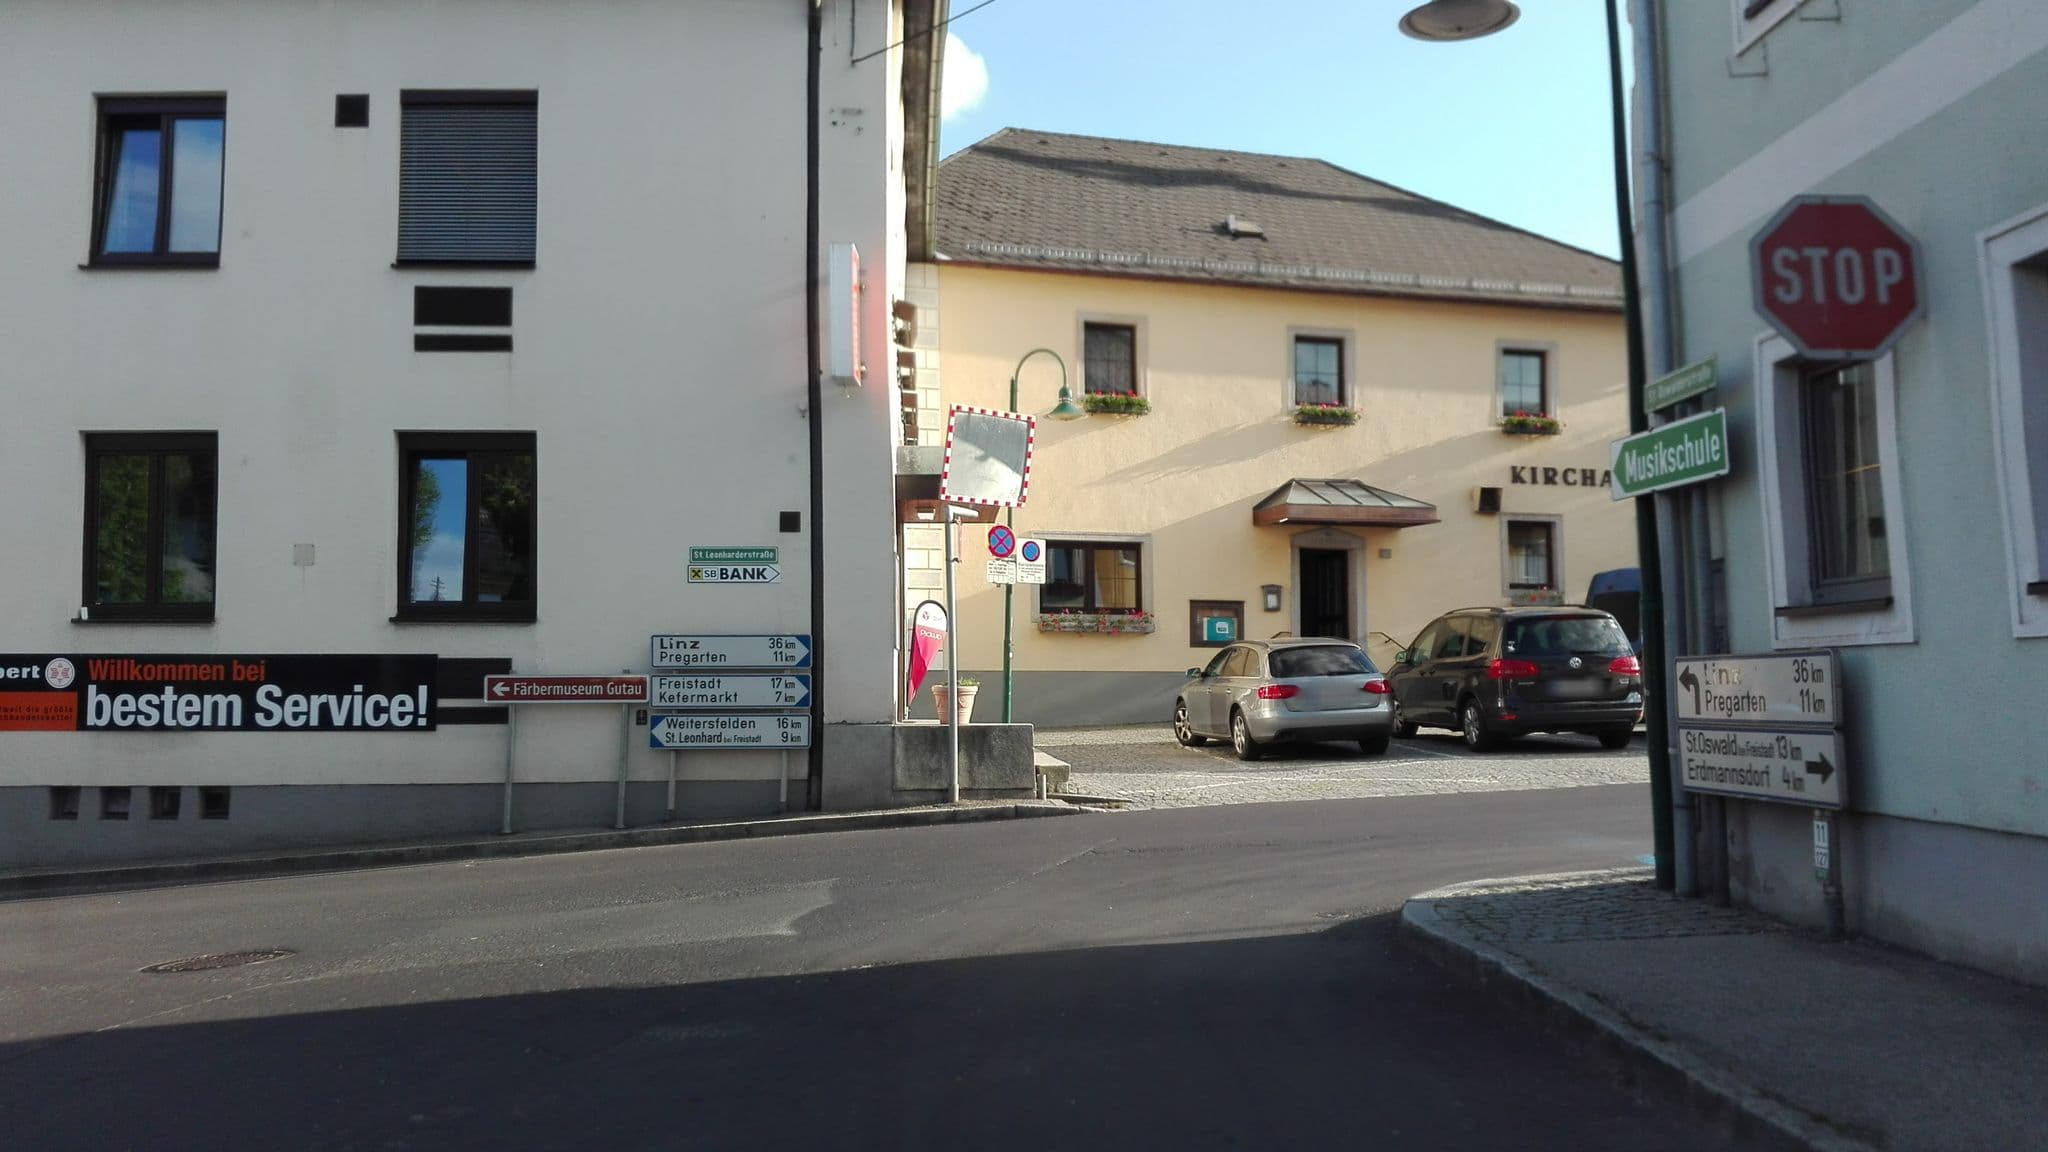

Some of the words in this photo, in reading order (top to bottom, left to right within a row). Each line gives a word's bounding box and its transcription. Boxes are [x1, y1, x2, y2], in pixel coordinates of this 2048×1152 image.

[1772, 247, 1903, 304] STOP
[1624, 427, 1721, 485] Musikschule
[706, 550, 775, 559] Leonharderstraße
[704, 569, 717, 578] SB
[720, 567, 768, 580] BANK
[660, 637, 700, 650] Linz
[768, 637, 783, 649] 36
[785, 640, 796, 650] km
[660, 651, 727, 665] Pregarten
[773, 651, 784, 662] 11
[785, 653, 796, 662] km
[88, 659, 225, 681] Willkommen
[232, 659, 266, 681] bei
[1792, 658, 1809, 684] 36
[1810, 663, 1824, 683] km
[513, 682, 604, 696] Färbermuseum
[606, 681, 642, 695] Gutau
[659, 677, 722, 689] Freistadt
[770, 677, 783, 689] 17
[784, 680, 796, 689] km
[659, 691, 738, 703] Kefermarkt
[775, 691, 782, 703] 7
[784, 694, 796, 703] km
[1705, 689, 1766, 717] Pregarten
[1799, 688, 1811, 713] 11
[1812, 692, 1826, 713] km
[86, 684, 242, 727] bestem
[255, 684, 429, 727] Service!
[666, 718, 756, 729] Weitersfelden
[776, 717, 789, 729] 16
[790, 720, 802, 729] km
[665, 732, 677, 744] St.
[679, 731, 722, 744] Leonhard
[781, 731, 789, 743] 9
[790, 733, 801, 743] km
[1775, 735, 1787, 760] 13
[1789, 740, 1802, 761] km
[1687, 758, 1770, 788] Erdmannsdorf
[1782, 765, 1791, 791] 4
[1792, 770, 1805, 792] km
